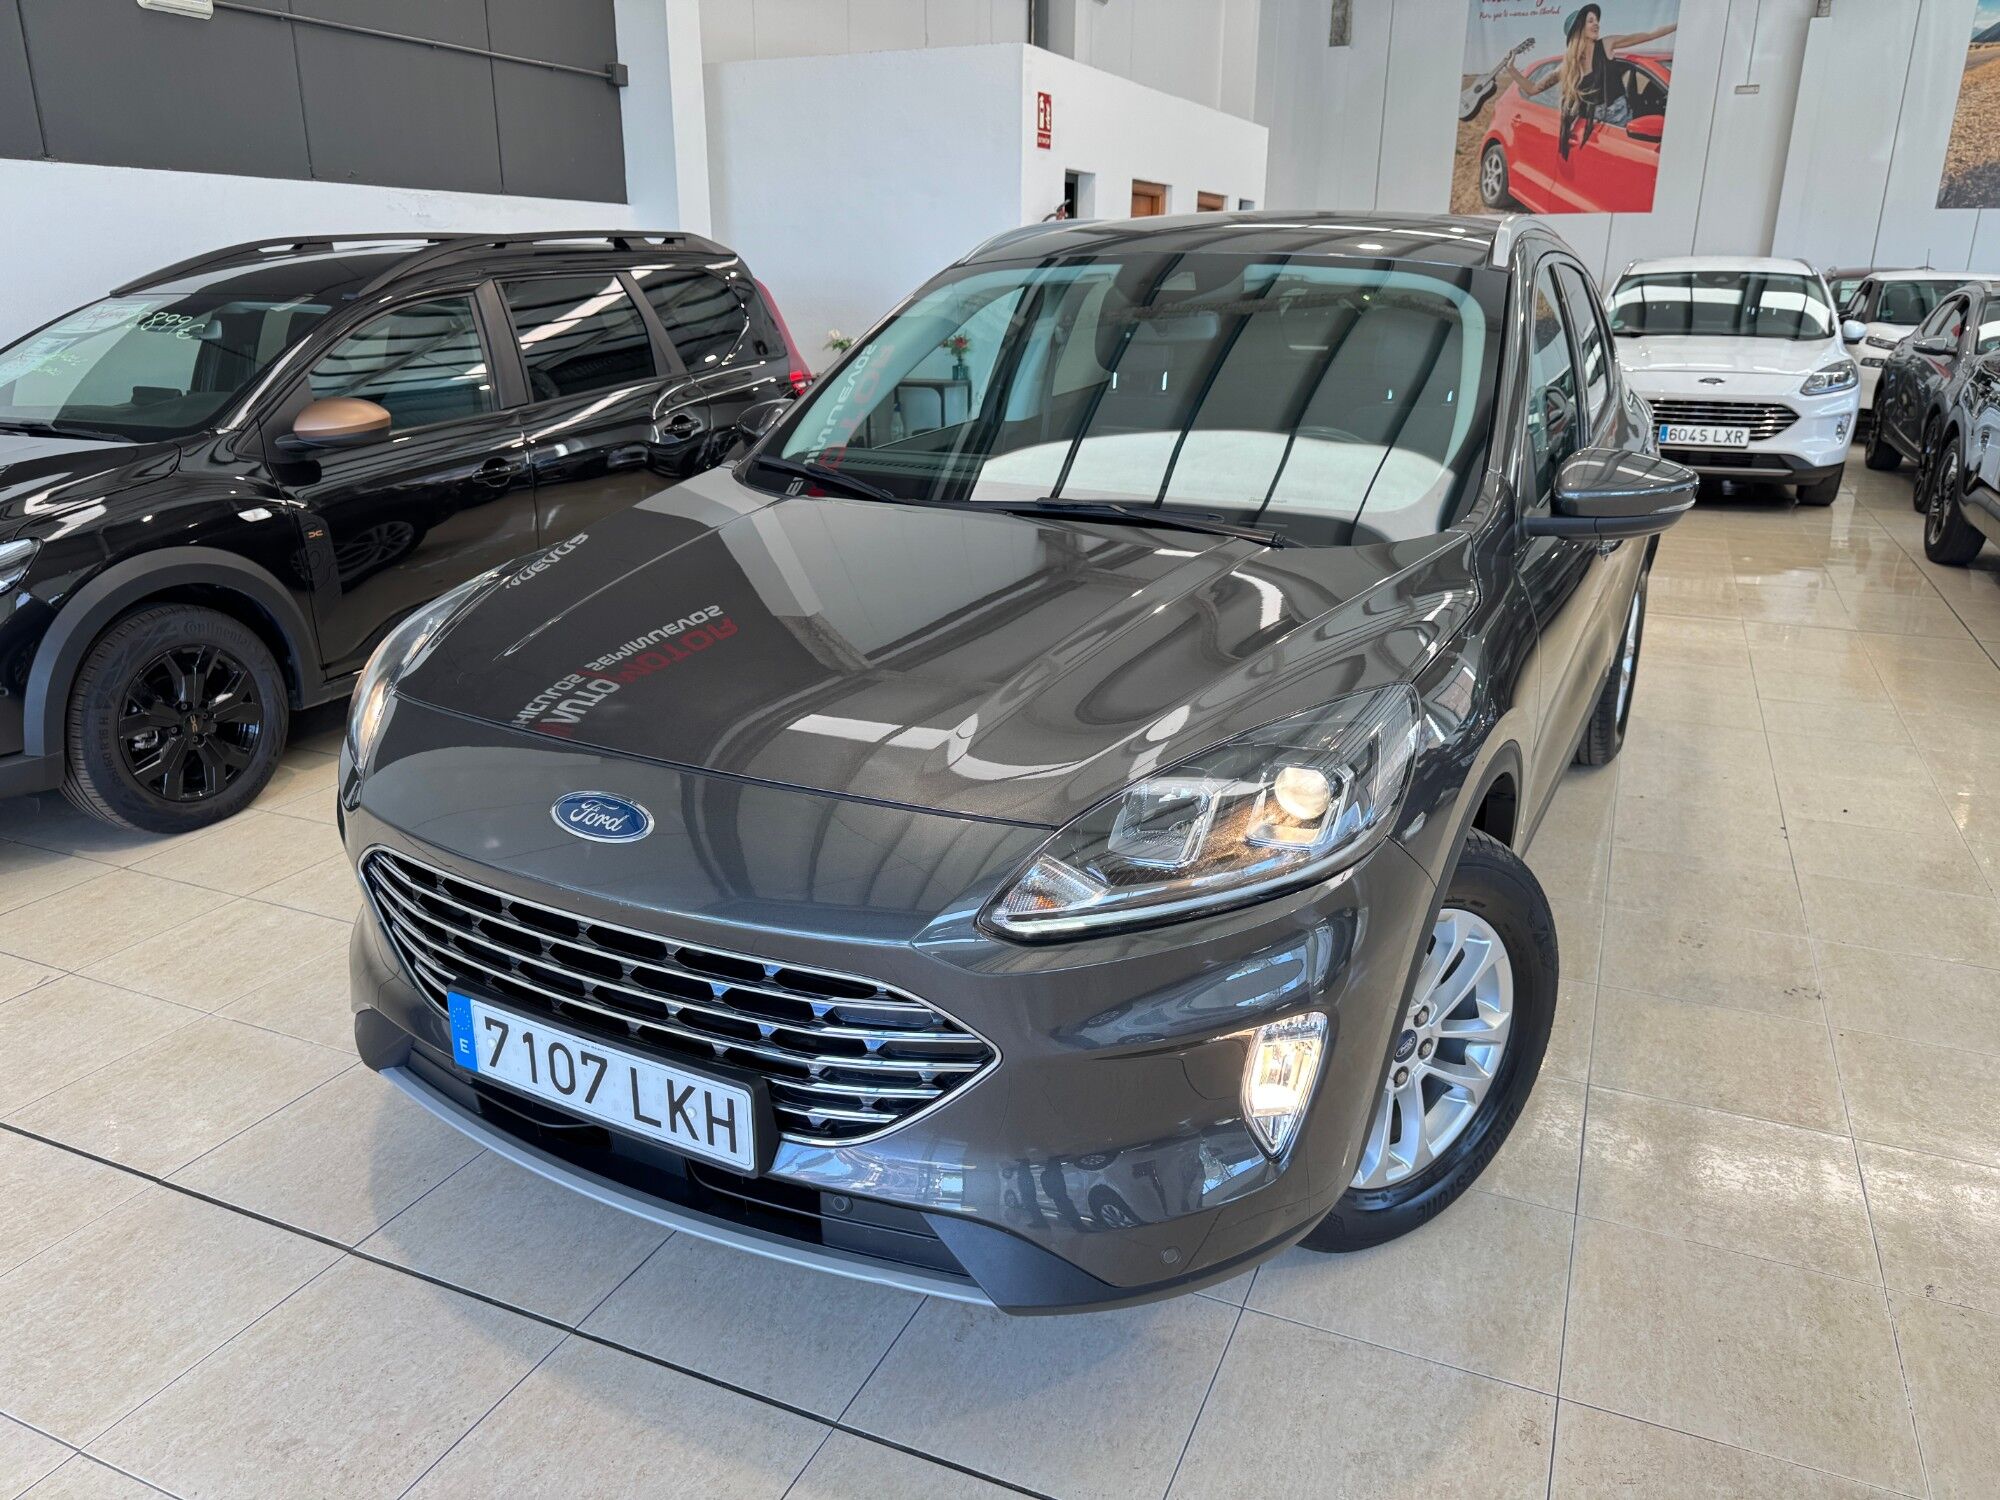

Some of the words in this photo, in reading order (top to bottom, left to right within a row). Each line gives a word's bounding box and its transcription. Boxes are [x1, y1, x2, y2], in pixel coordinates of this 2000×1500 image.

[1669, 428, 1708, 442] 6045
[1713, 430, 1744, 443] LXR
[570, 799, 630, 832] Ford
[459, 1037, 470, 1054] E
[485, 1016, 608, 1104] 7107
[630, 1067, 737, 1154] LKH
